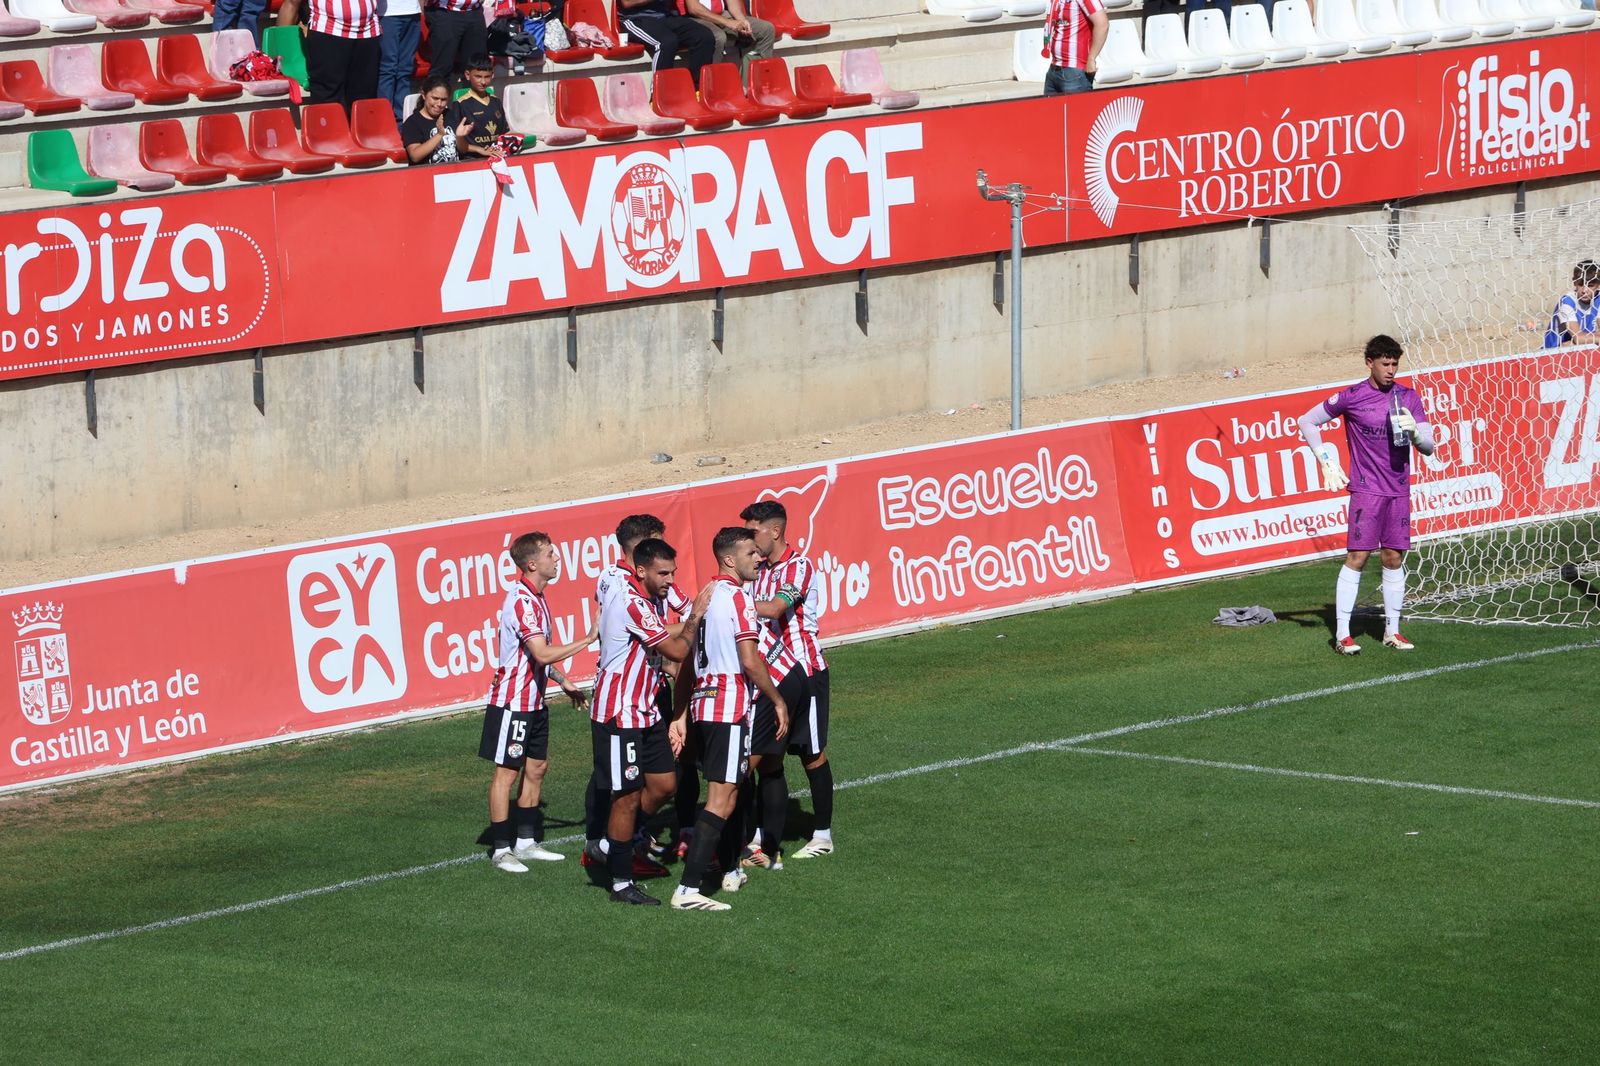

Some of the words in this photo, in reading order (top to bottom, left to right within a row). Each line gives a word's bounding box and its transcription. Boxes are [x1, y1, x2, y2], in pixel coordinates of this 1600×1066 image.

[1468, 50, 1574, 131] fisio
[1110, 126, 1262, 184] CENTRO
[1272, 107, 1405, 164] ÓPTICO
[1469, 103, 1591, 165] readapt
[1178, 160, 1341, 218] ROBERTO
[1469, 155, 1555, 177] POLICLÍNICA
[433, 138, 804, 313] ZAMORA
[806, 121, 924, 265] CF
[71, 322, 84, 343] Y
[95, 303, 229, 341] JAMONES
[1230, 410, 1342, 446] bodes
[877, 447, 1098, 531] Escuela
[416, 532, 517, 605] Carné
[888, 515, 1110, 607] infantil
[81, 678, 160, 714] Junta
[166, 668, 200, 698] de
[10, 725, 110, 767] Castilla
[114, 724, 131, 757] y
[139, 708, 207, 745] León
[511, 720, 528, 742] 15
[626, 741, 637, 764] 6
